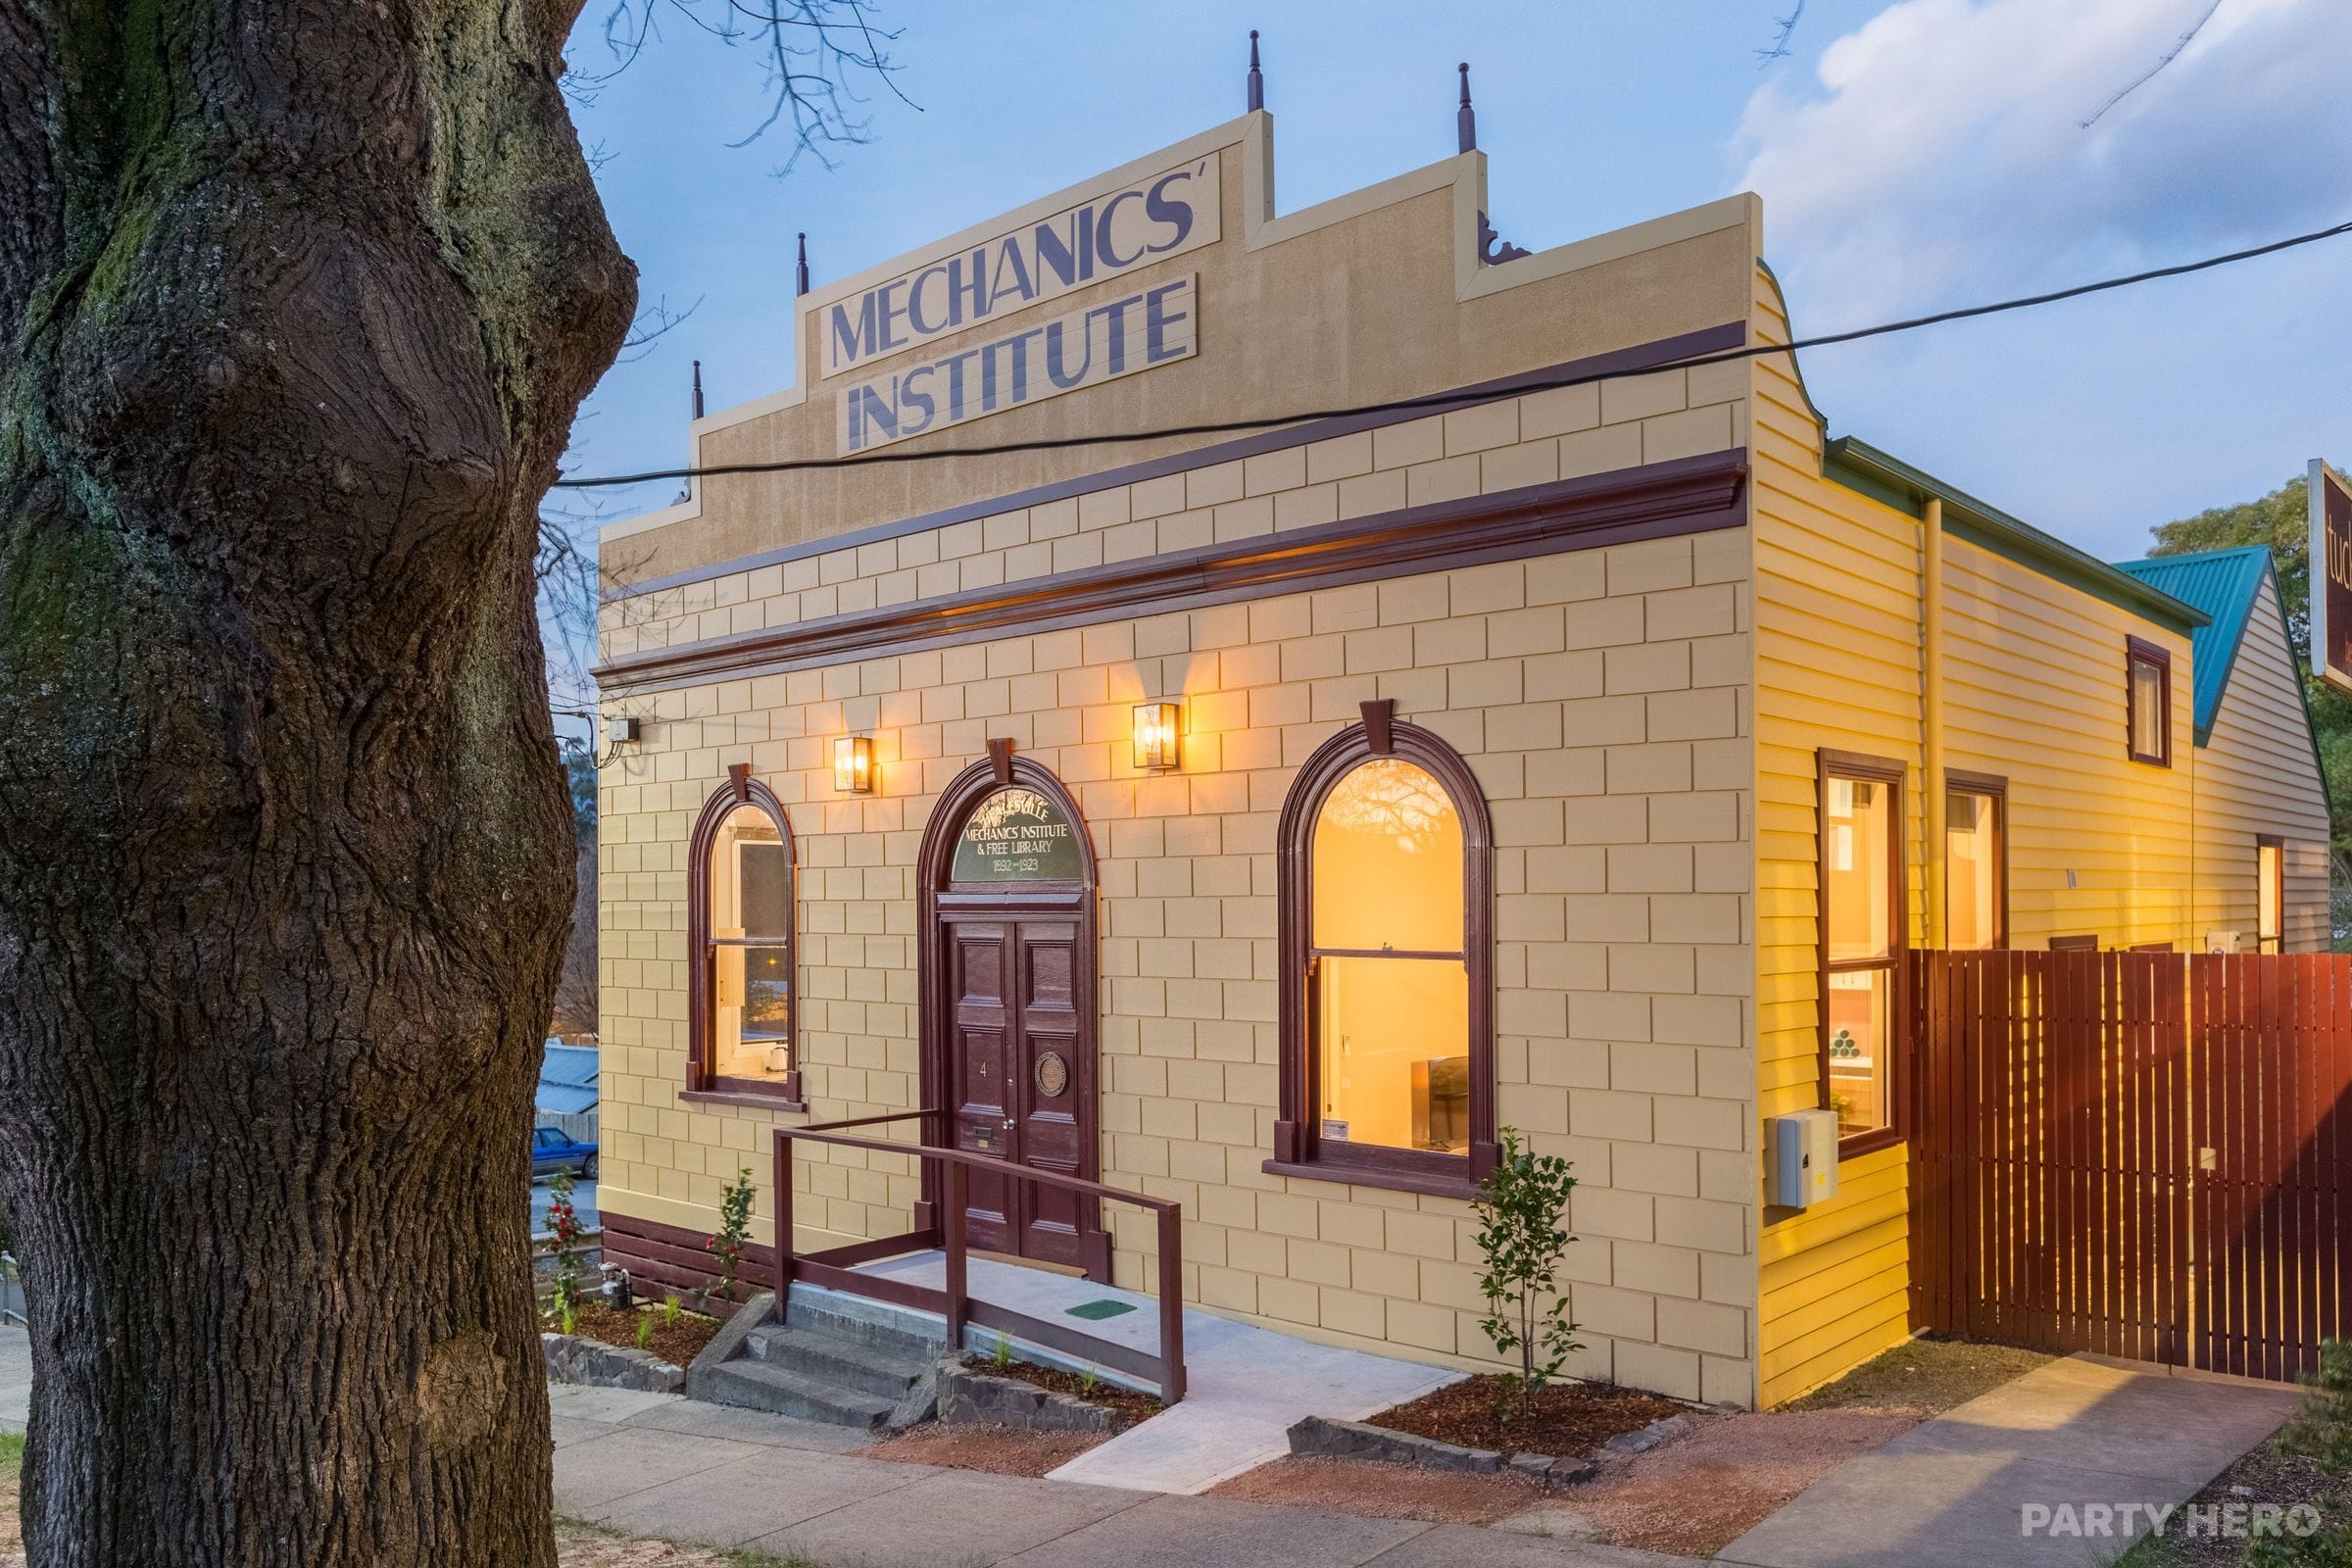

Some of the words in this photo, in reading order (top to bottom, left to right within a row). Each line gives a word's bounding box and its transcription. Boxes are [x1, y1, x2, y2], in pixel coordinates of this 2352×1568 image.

[832, 161, 1206, 368] MECHANICS'
[848, 279, 1187, 451] INSTITUTE
[1021, 824, 1068, 839] INSTITUTE
[977, 843, 985, 856] &
[986, 842, 1008, 856] FREE
[1011, 840, 1054, 854] LIBRARY
[980, 1061, 987, 1078] 4
